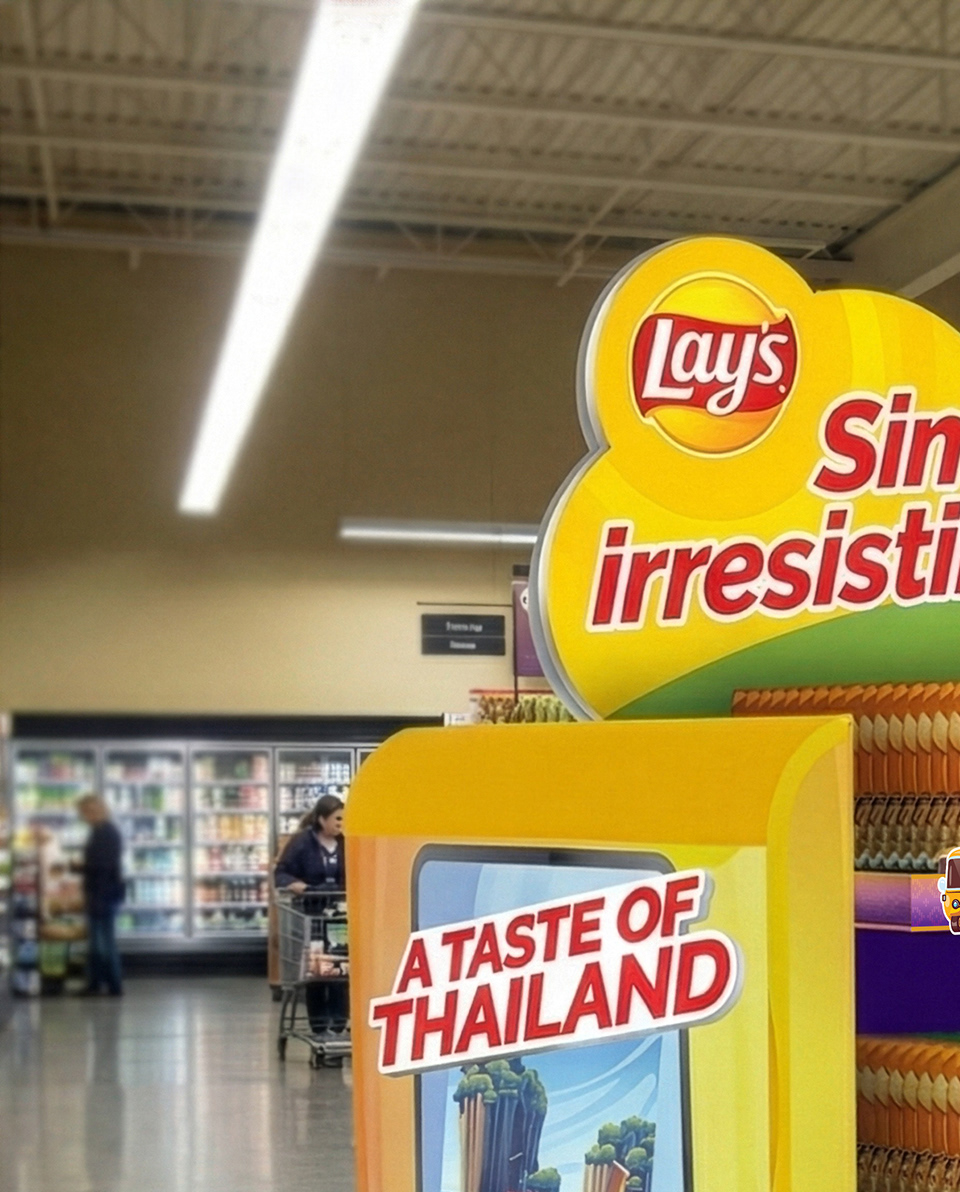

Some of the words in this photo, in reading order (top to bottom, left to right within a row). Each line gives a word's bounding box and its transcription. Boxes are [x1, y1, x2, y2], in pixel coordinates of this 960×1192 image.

[641, 319, 789, 416] Lay's
[396, 938, 433, 994] A
[441, 897, 606, 982] TASTE
[616, 875, 700, 944] OF
[373, 938, 732, 1067] THAILAND
